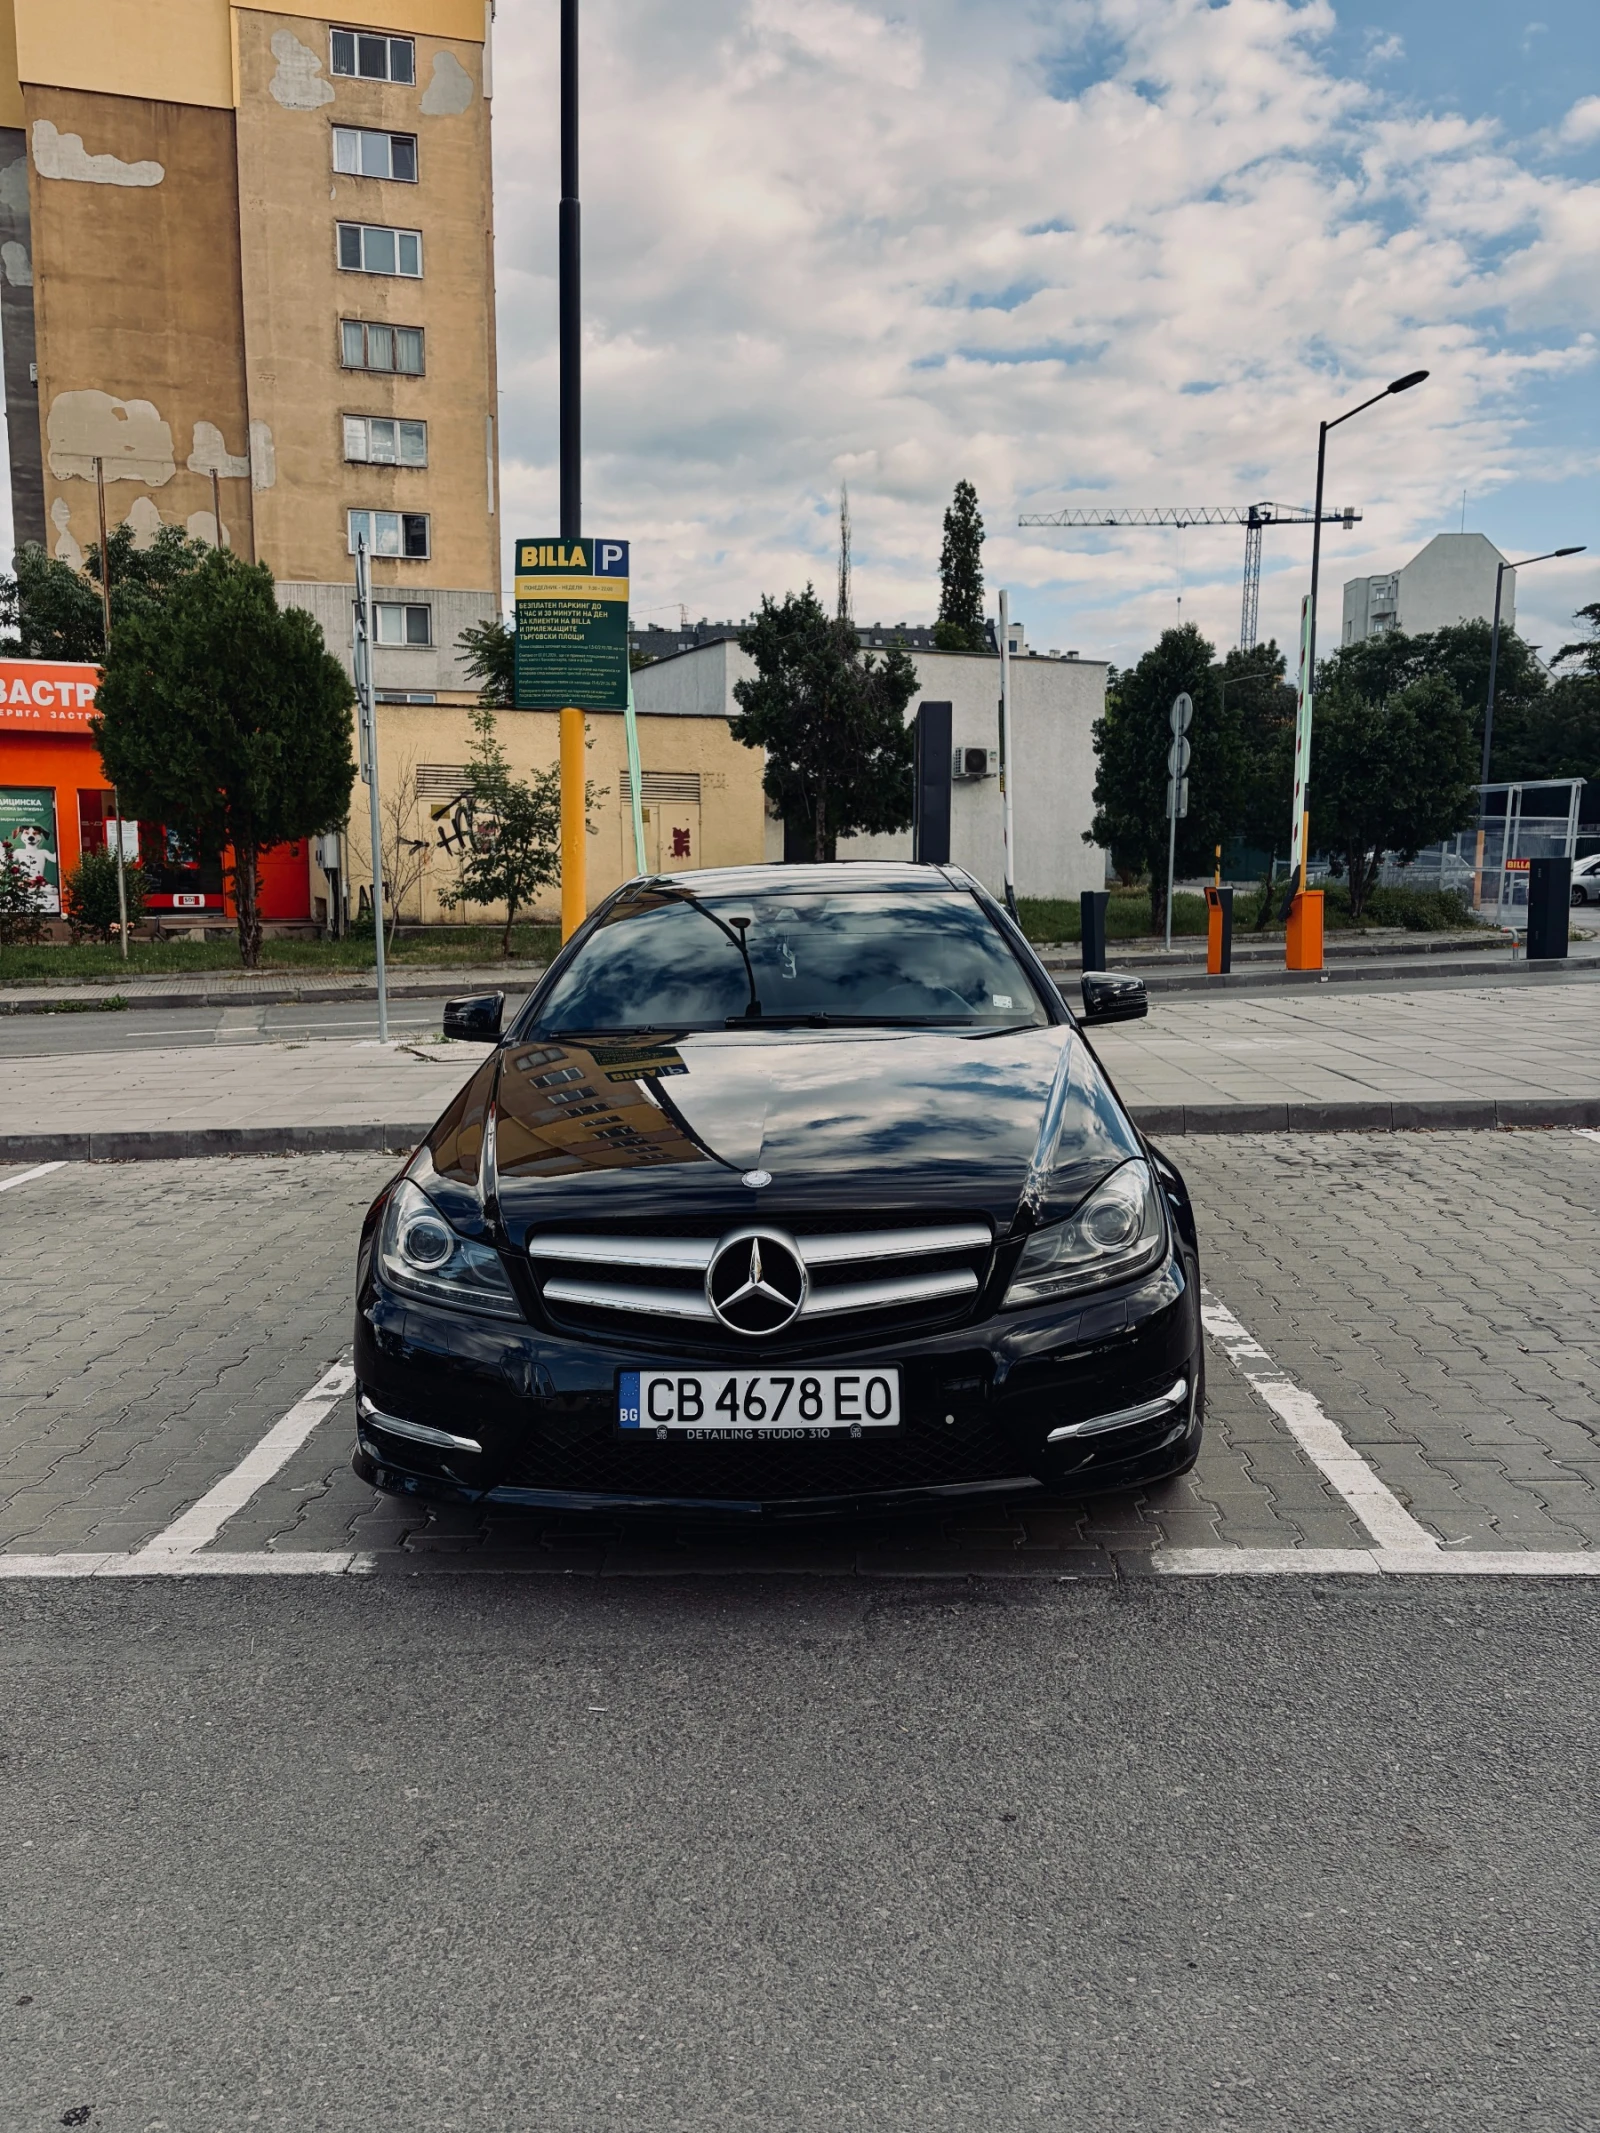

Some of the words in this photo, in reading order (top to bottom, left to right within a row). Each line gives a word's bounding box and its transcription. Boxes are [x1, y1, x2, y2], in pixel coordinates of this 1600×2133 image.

[521, 545, 587, 567] BILLA
[602, 544, 623, 570] P
[1507, 860, 1530, 869] BILLA
[647, 1377, 704, 1422] CB
[715, 1377, 823, 1421] 4678
[835, 1376, 892, 1421] EO
[619, 1408, 638, 1422] BG
[687, 1429, 755, 1440] DETAILING
[758, 1428, 805, 1440] STUDIO
[809, 1428, 830, 1439] 310
